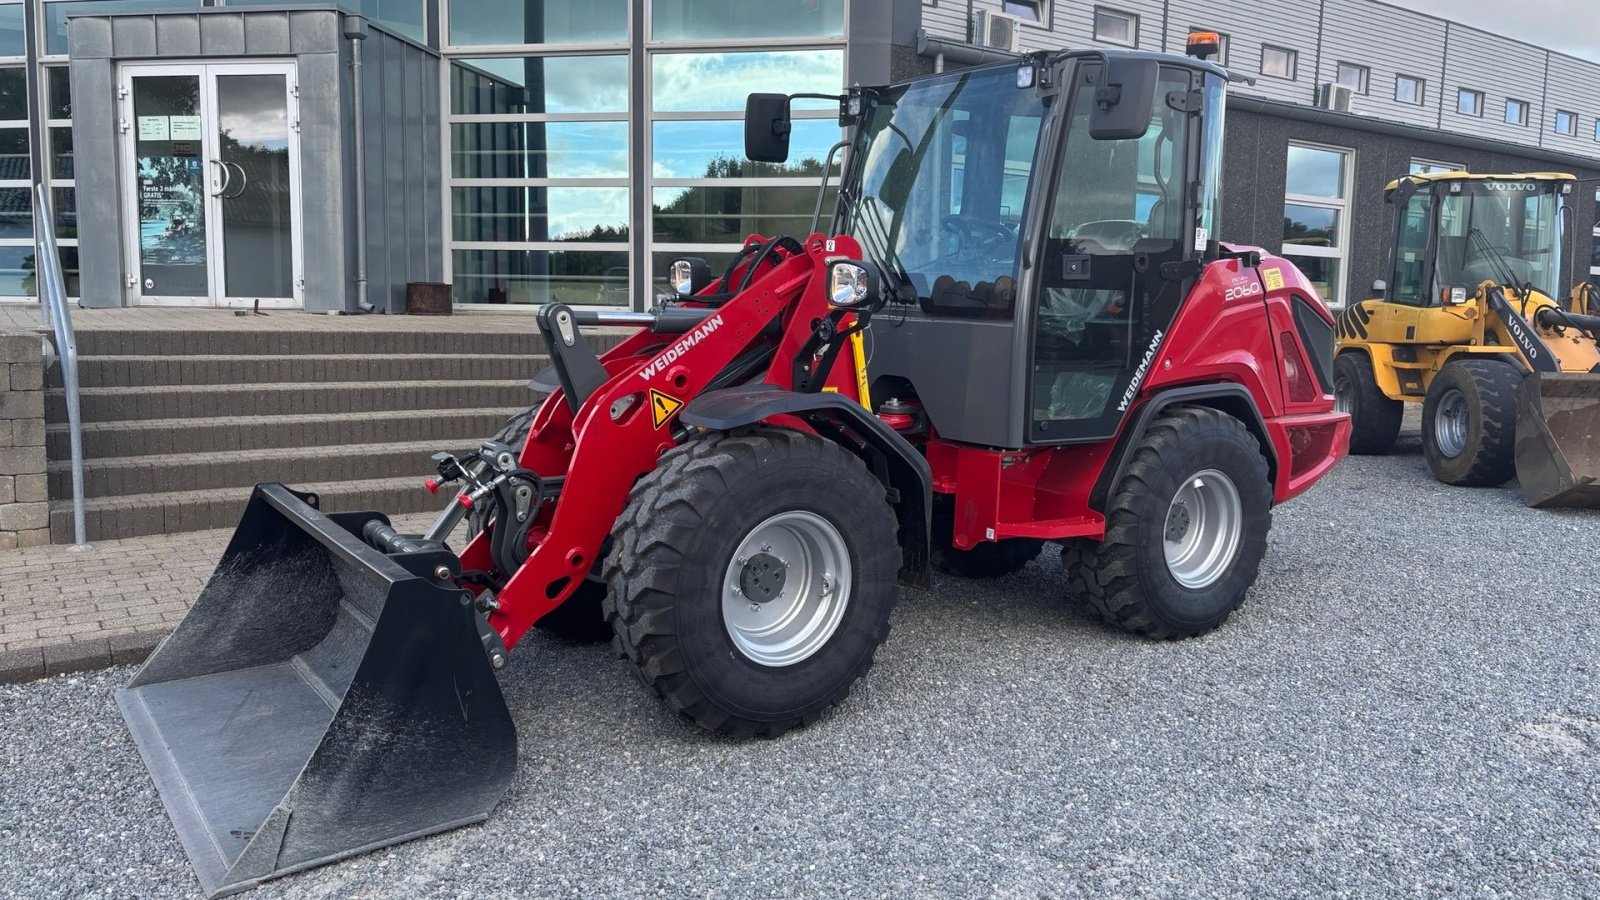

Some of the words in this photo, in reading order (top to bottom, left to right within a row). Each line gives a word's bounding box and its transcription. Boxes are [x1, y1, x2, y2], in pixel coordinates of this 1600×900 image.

[1482, 182, 1536, 191] VOLVO
[1225, 282, 1259, 301] 2060
[638, 314, 724, 381] WEIDEMANN
[1508, 313, 1537, 359] VOLVO
[1117, 329, 1163, 412] WEIDEMANN
